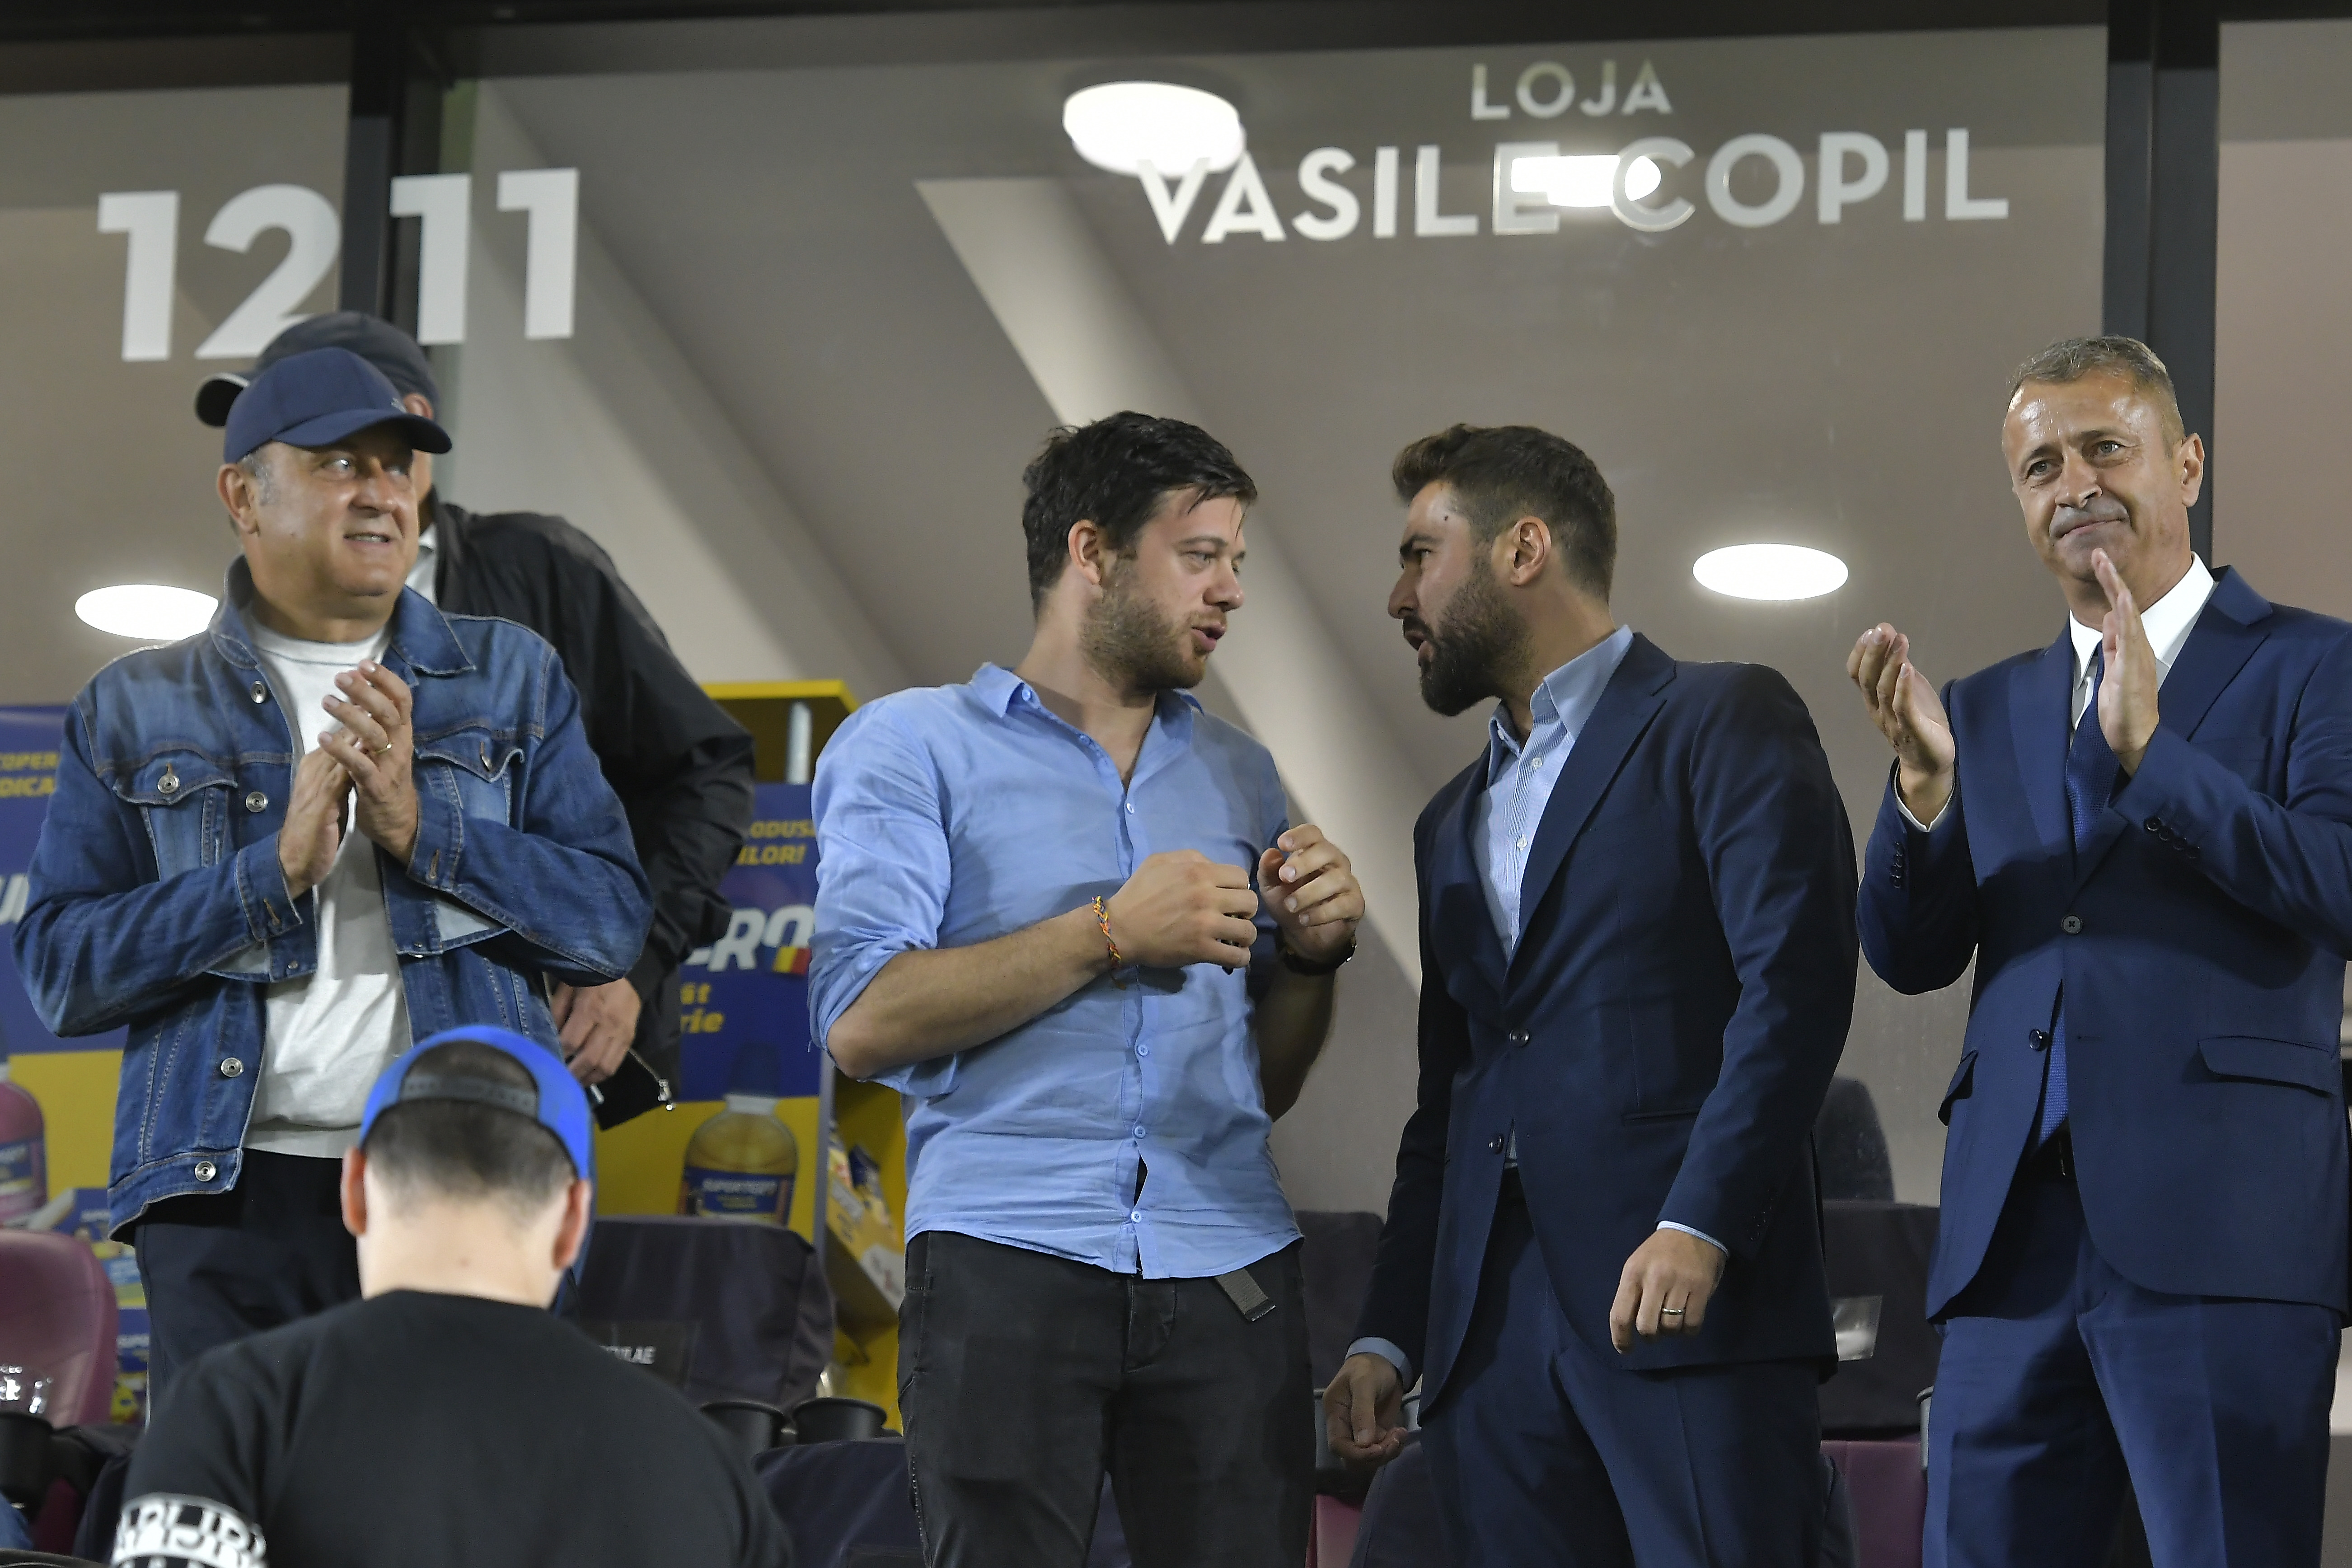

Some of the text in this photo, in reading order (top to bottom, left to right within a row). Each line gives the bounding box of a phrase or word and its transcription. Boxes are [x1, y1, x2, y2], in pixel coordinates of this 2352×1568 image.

[1471, 59, 1673, 120] LOJA
[390, 167, 579, 346] 11
[1136, 128, 2009, 245] VASILE COPIL
[97, 183, 342, 361] 12
